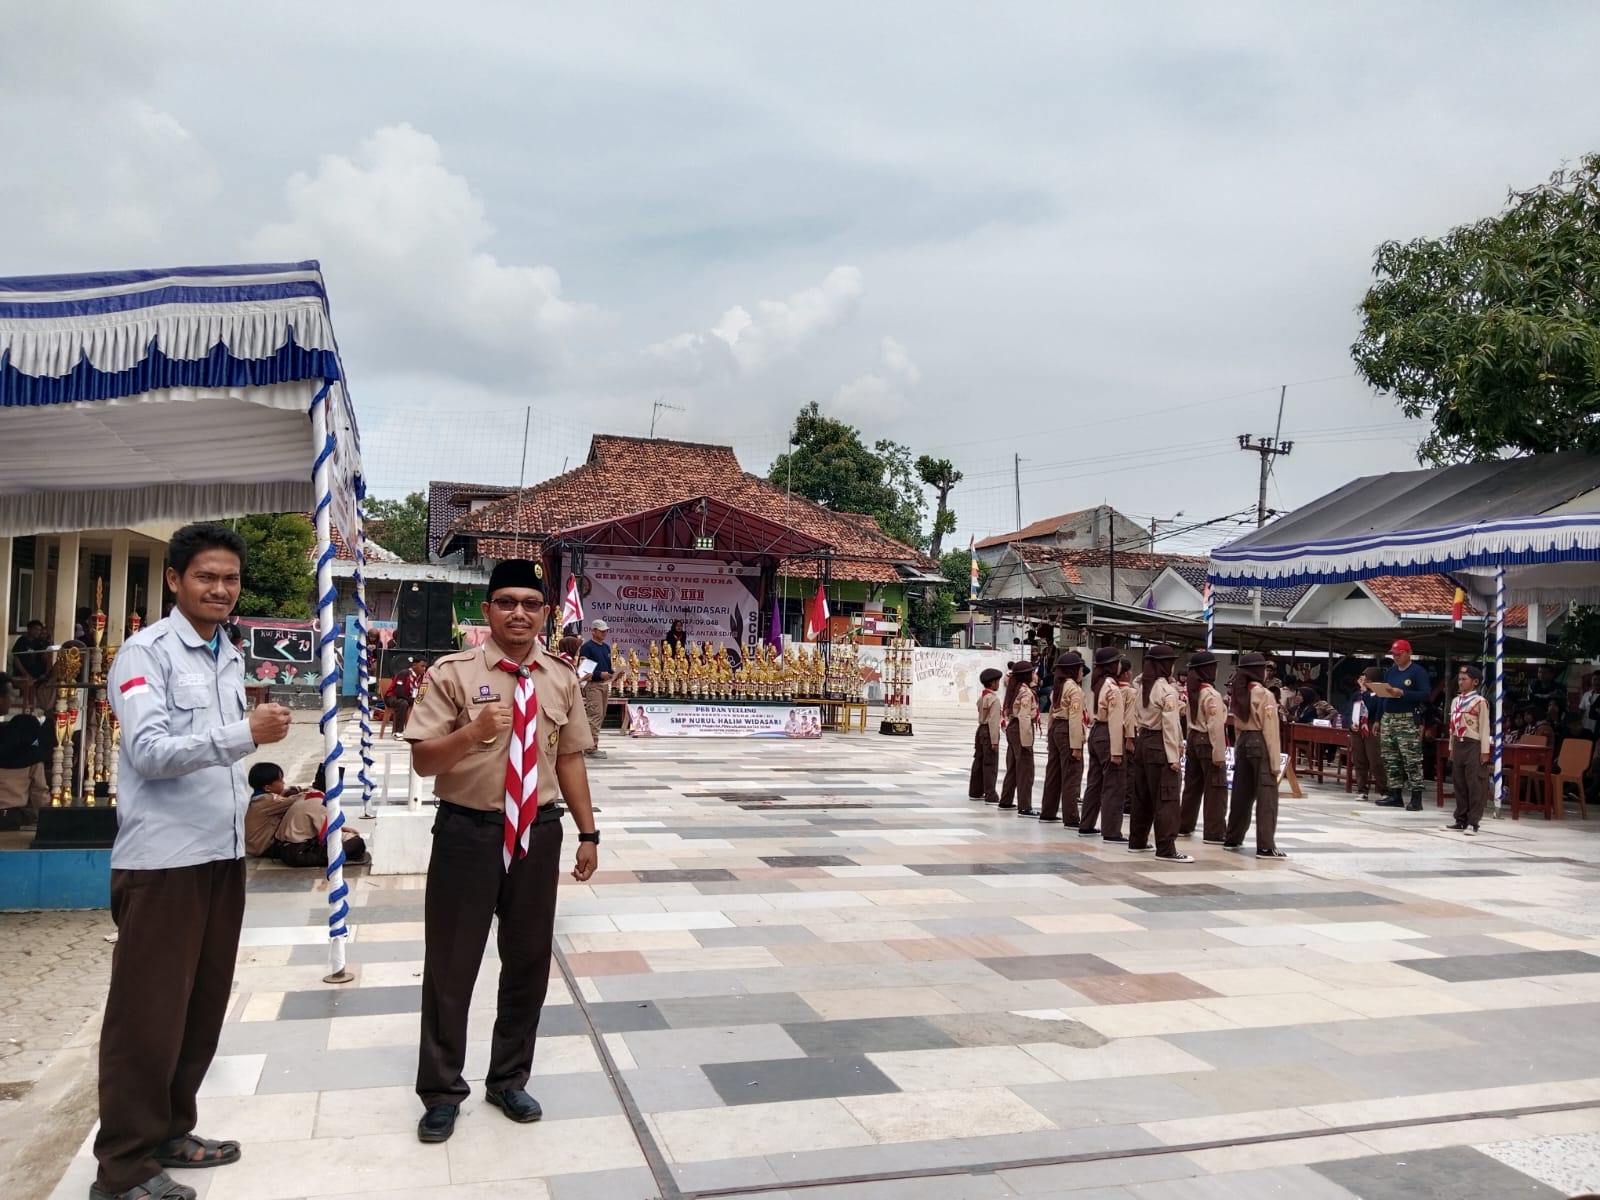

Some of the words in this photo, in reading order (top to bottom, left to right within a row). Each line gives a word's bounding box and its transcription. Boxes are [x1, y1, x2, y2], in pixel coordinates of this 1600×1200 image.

[595, 573, 640, 581] GEBYAR
[643, 575, 700, 584] SCOUTING
[702, 577, 733, 585] NUHA
[616, 585, 676, 602] (GSN)
[680, 588, 705, 602] III
[591, 601, 612, 610] SMP
[614, 602, 649, 612] NURUL
[651, 604, 682, 613] HALIM
[745, 718, 782, 726] WIDASARI
